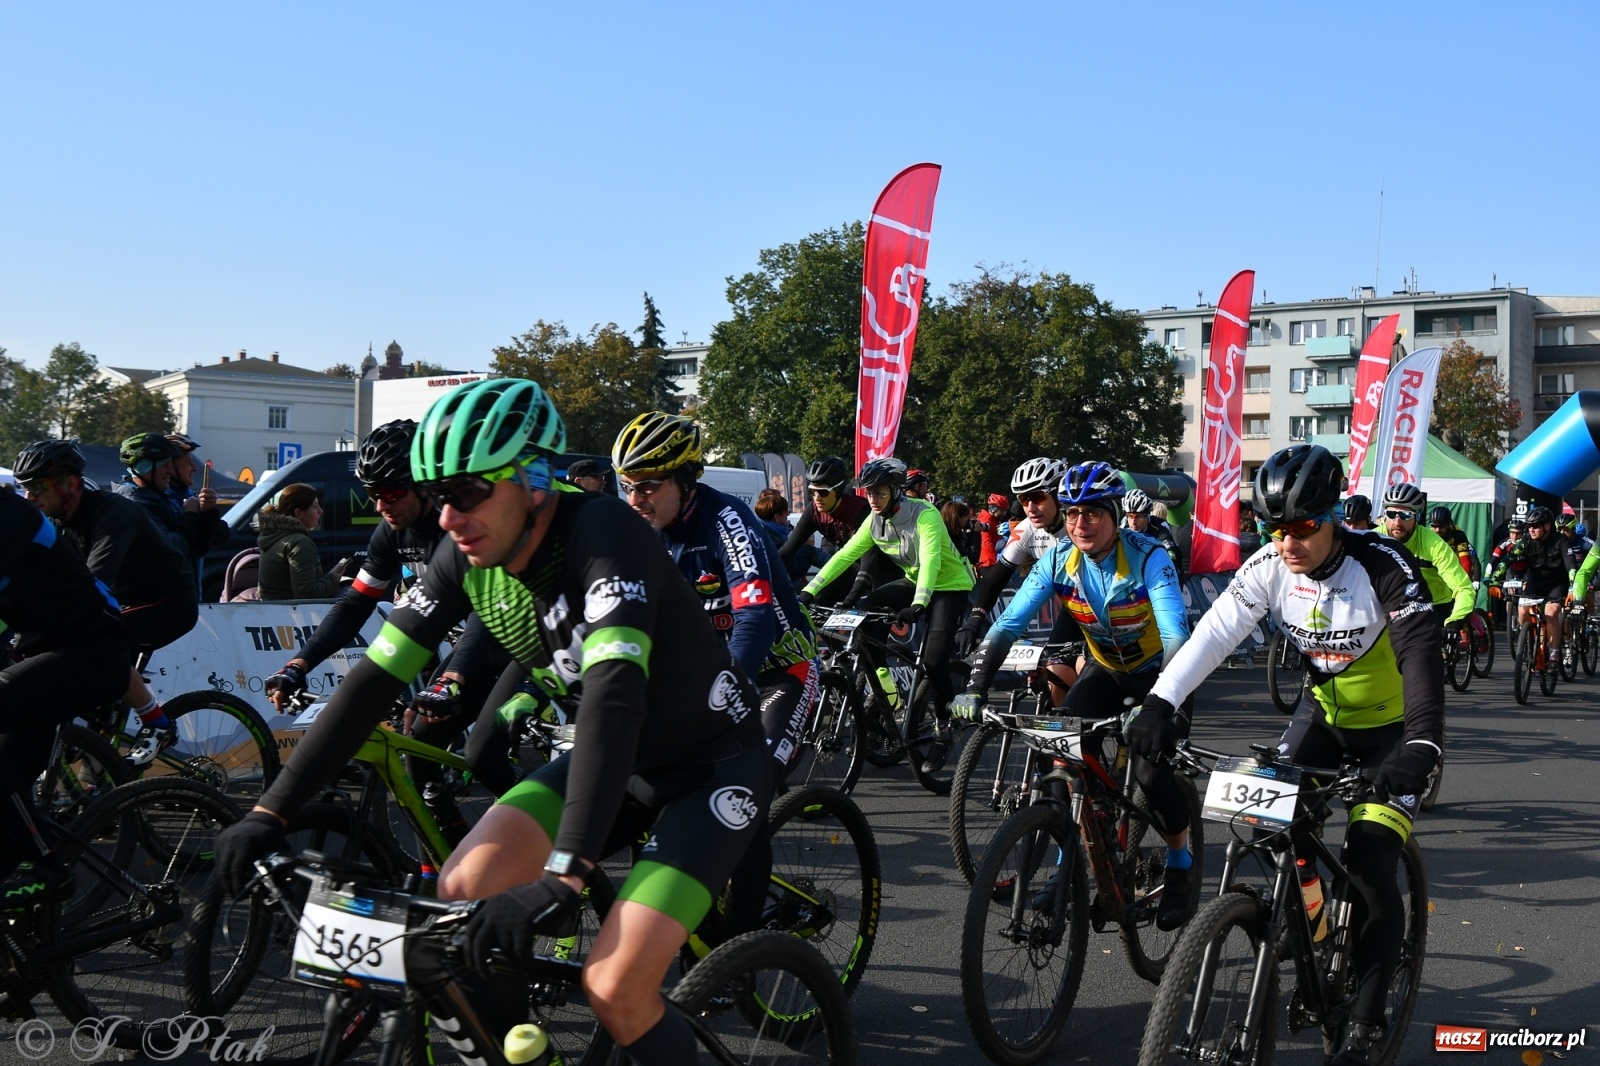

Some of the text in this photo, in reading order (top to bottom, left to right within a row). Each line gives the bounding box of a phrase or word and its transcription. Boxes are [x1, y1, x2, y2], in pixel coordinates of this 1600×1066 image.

[1388, 369, 1424, 487] RACIBÓ
[718, 505, 760, 579] MOTOREX
[1368, 542, 1414, 580] MERIDA
[601, 576, 646, 598] kiwi
[831, 617, 856, 625] 2754
[1282, 621, 1366, 641] MERIDA
[1288, 633, 1363, 651] MULTIVAN
[725, 682, 752, 719] kiwi
[785, 658, 817, 737] LANGENAKEN
[1220, 782, 1281, 810] 1347
[316, 924, 383, 968] 1565
